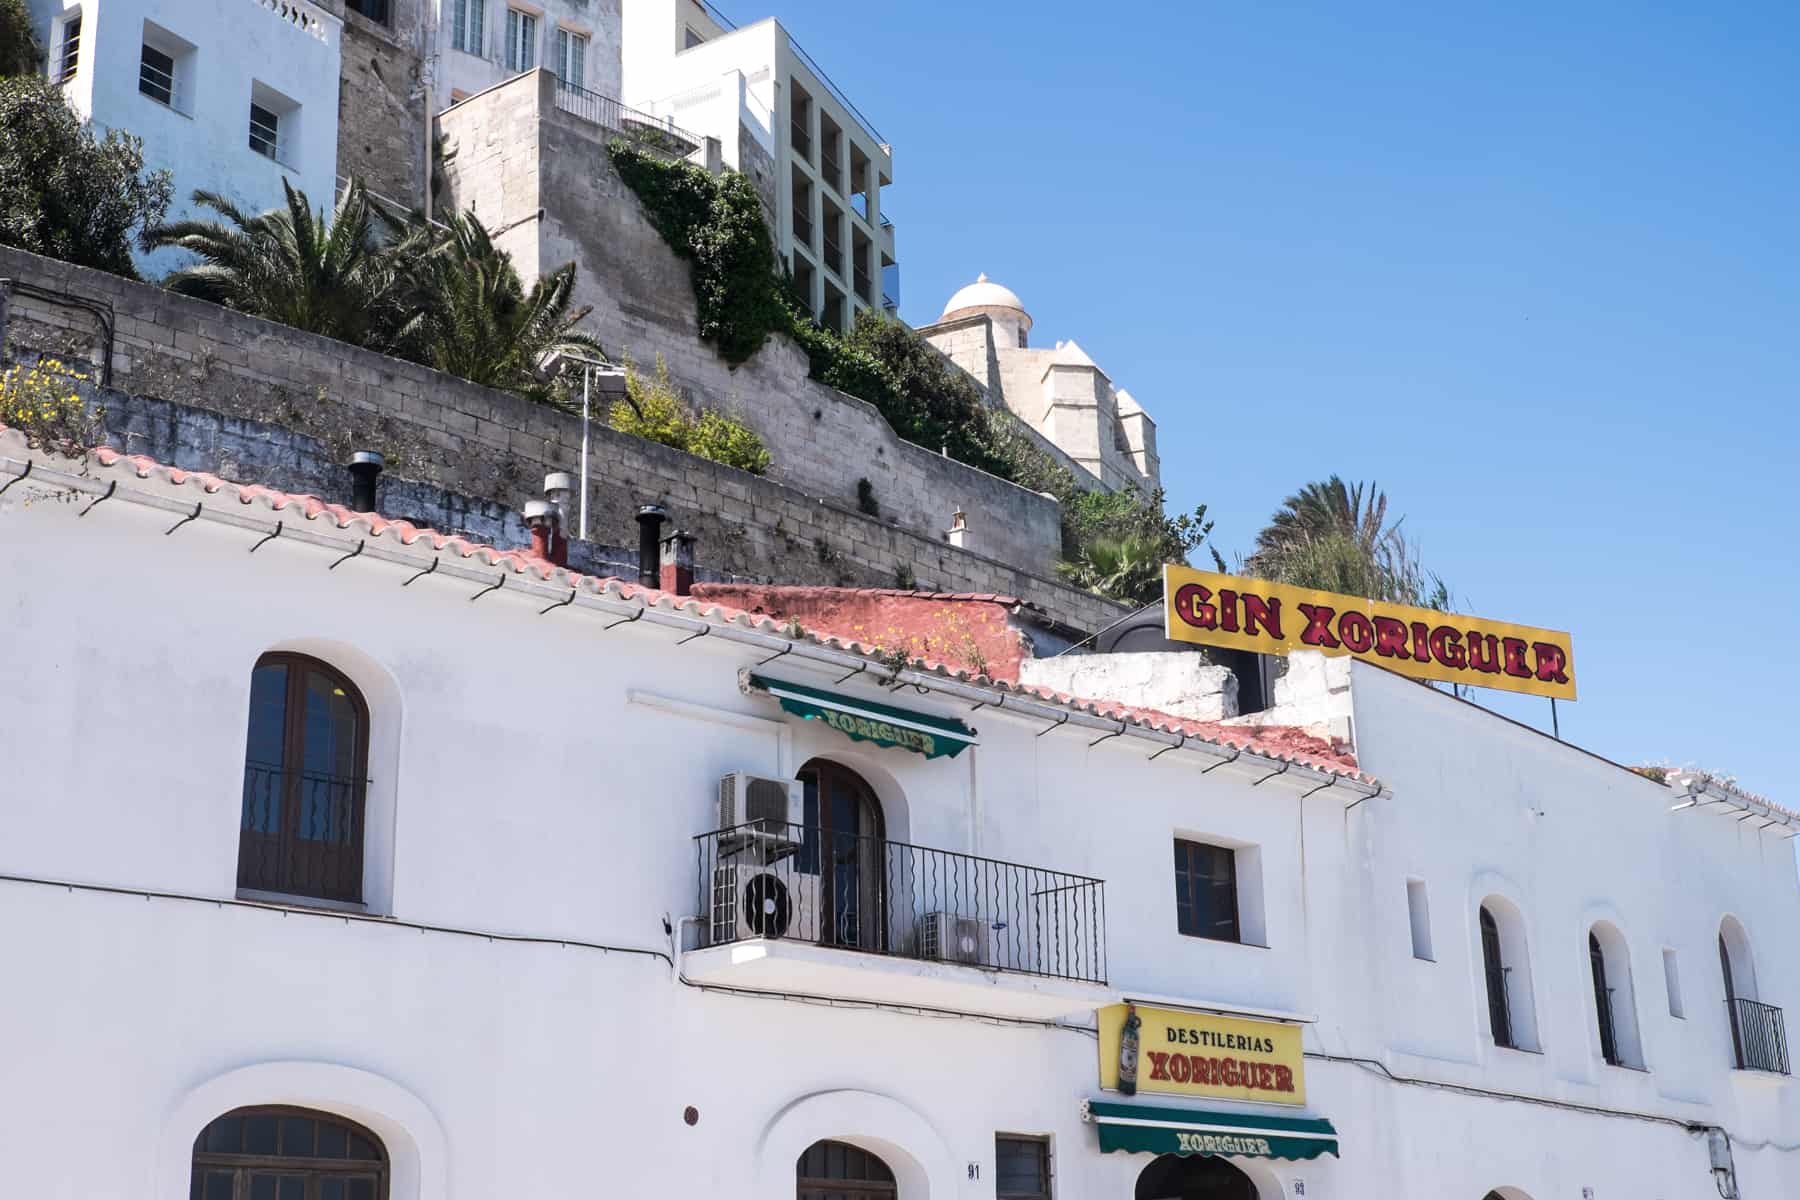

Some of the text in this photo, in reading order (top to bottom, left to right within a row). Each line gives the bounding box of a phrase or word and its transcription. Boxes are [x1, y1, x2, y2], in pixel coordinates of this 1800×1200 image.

[1174, 583, 1570, 684] GIN XORIGUER
[822, 708, 935, 754] XORIGUER
[1167, 1027, 1273, 1053] DESTILERIAS
[1147, 1051, 1295, 1093] XORIGUER
[1176, 1133, 1272, 1154] XORIGUER
[967, 1164, 980, 1180] 91
